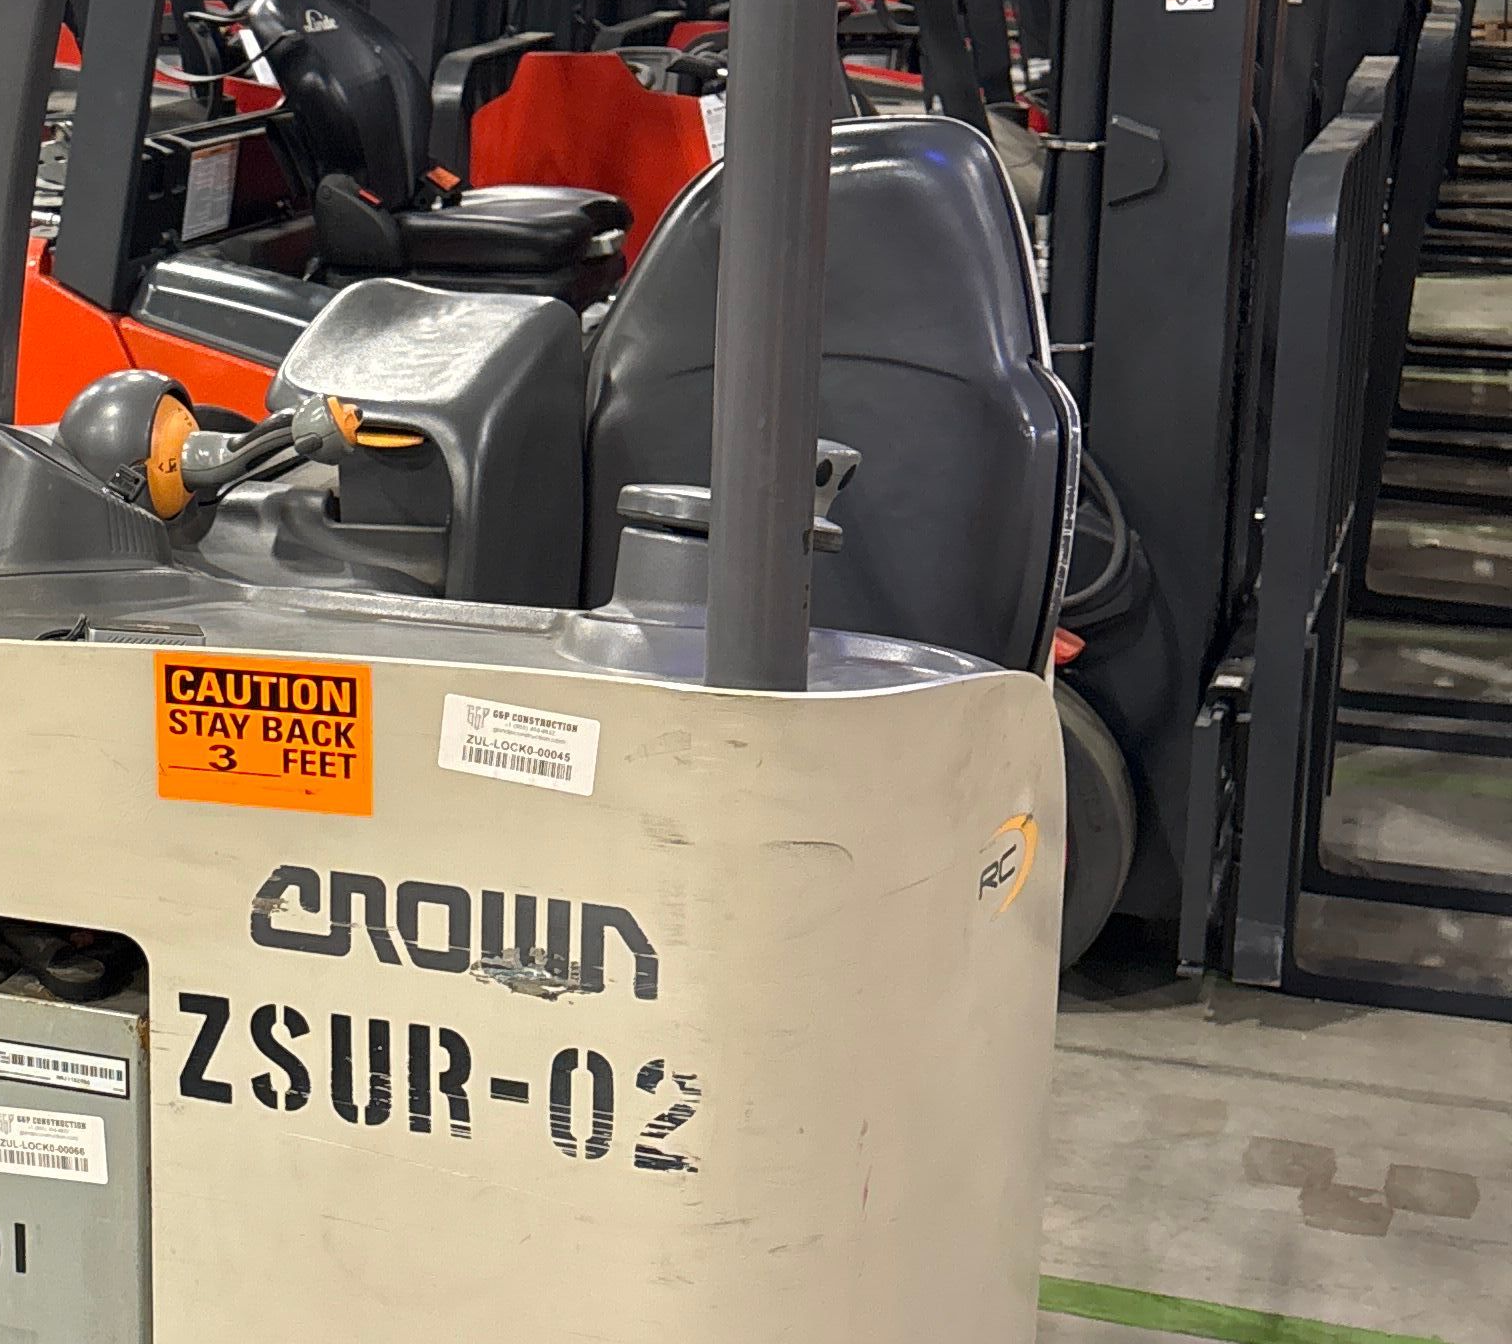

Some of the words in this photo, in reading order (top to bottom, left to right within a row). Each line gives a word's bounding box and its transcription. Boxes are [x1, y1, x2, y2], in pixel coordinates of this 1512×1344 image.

[170, 669, 352, 714] CAUTION
[168, 708, 251, 741] STAY
[262, 715, 356, 750] BACK
[511, 713, 579, 734] CONSTRUCTION
[208, 744, 238, 772] 3
[282, 747, 358, 780] FEET
[978, 843, 1017, 901] RC
[250, 864, 660, 1001] CROWN
[178, 991, 703, 1174] ZSUR-02
